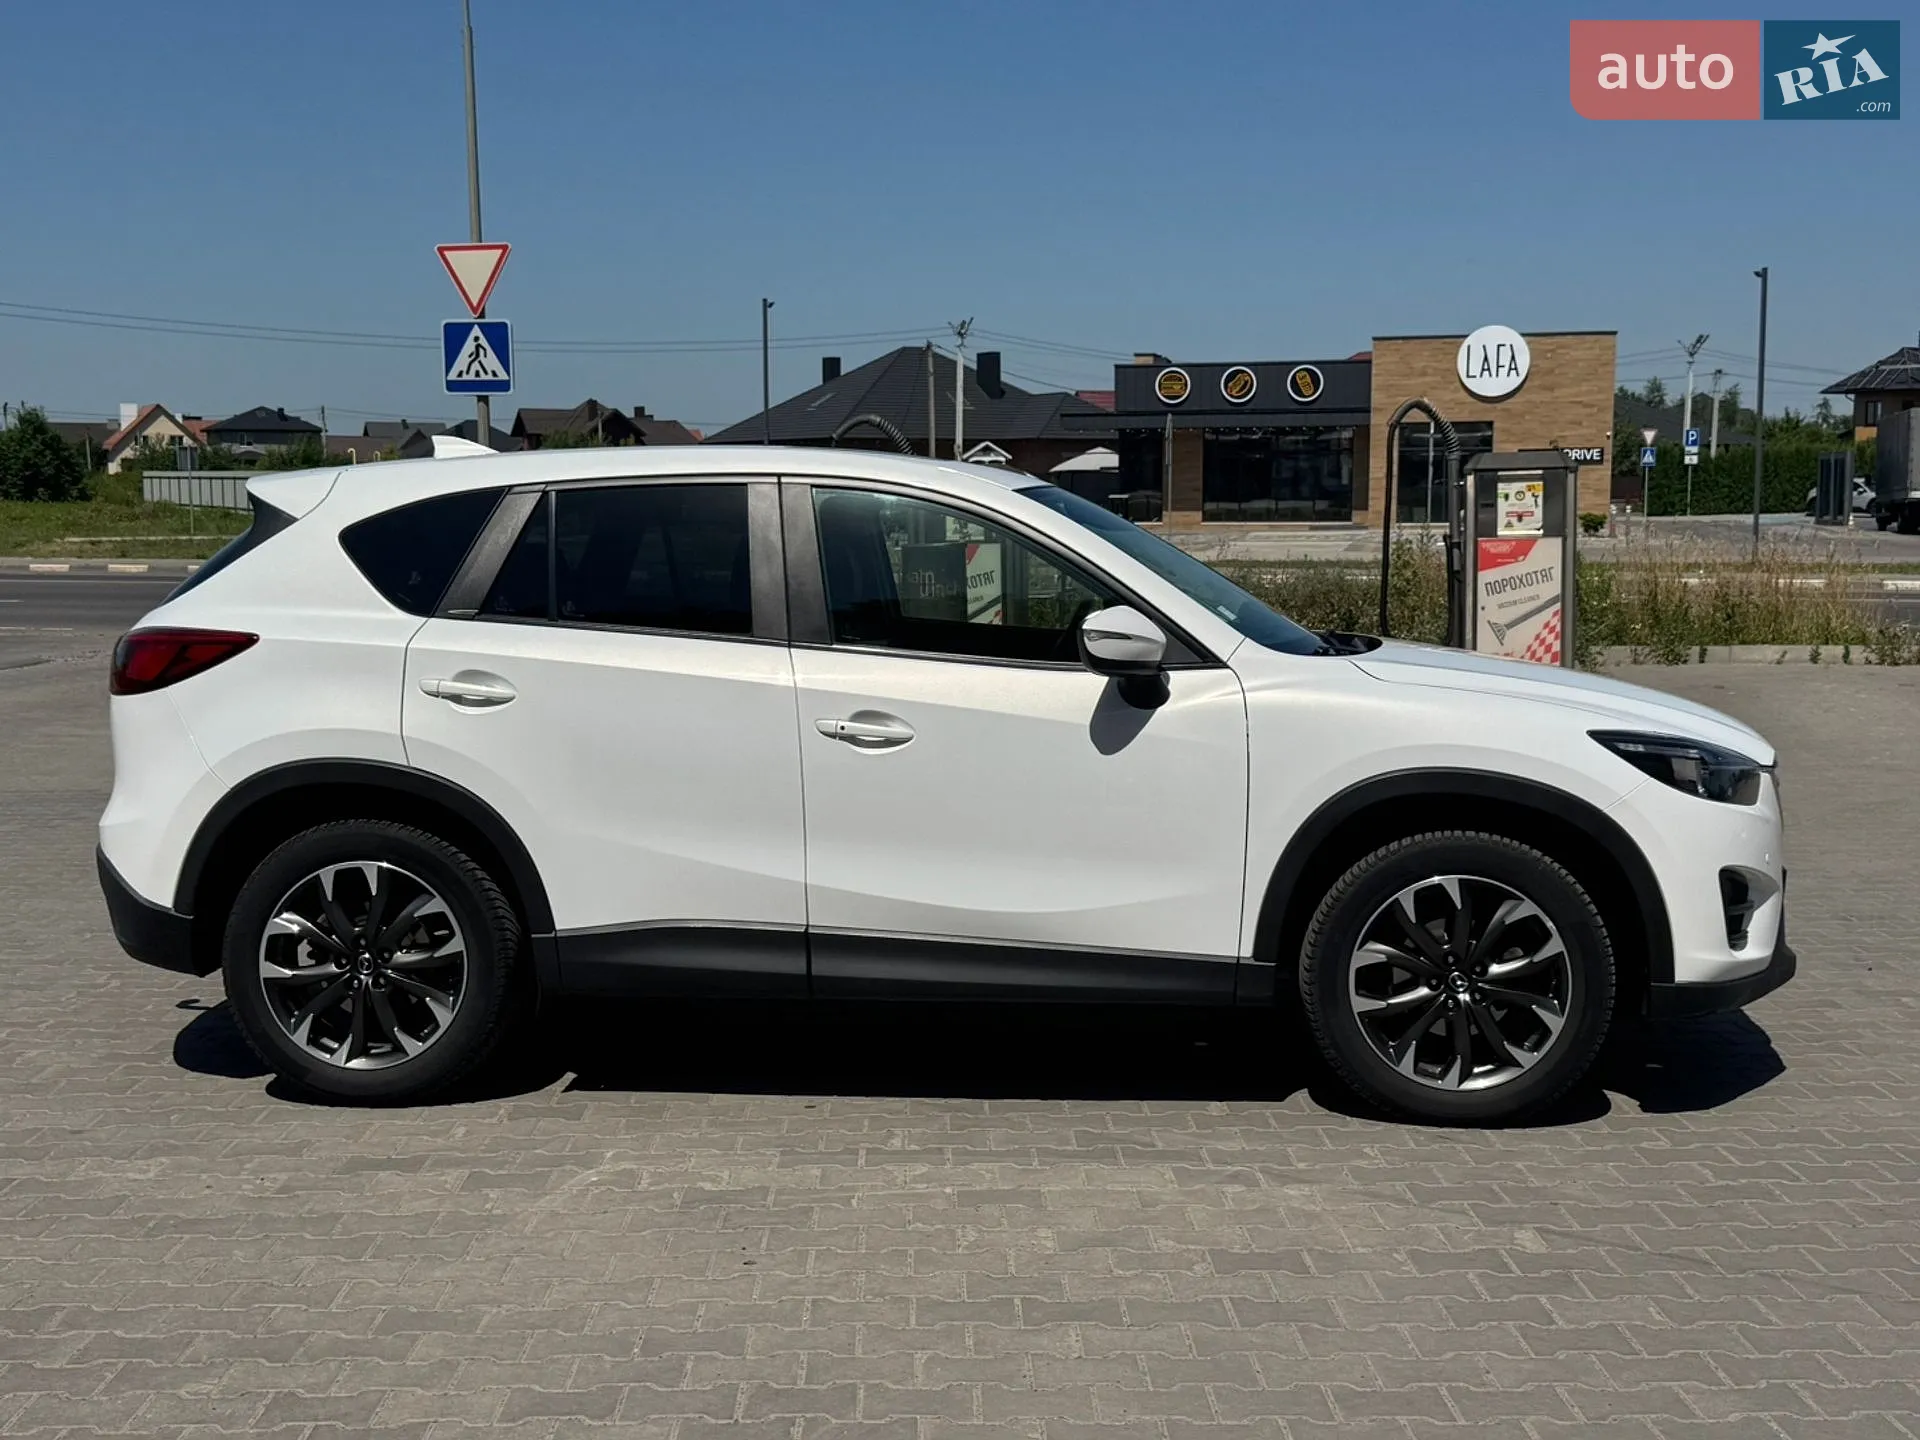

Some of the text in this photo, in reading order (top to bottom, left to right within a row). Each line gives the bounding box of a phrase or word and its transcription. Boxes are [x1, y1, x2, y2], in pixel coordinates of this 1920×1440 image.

[1465, 343, 1520, 379] LAFA
[1688, 430, 1698, 445] P
[1484, 566, 1554, 597] ПОРОХОТЯГ
